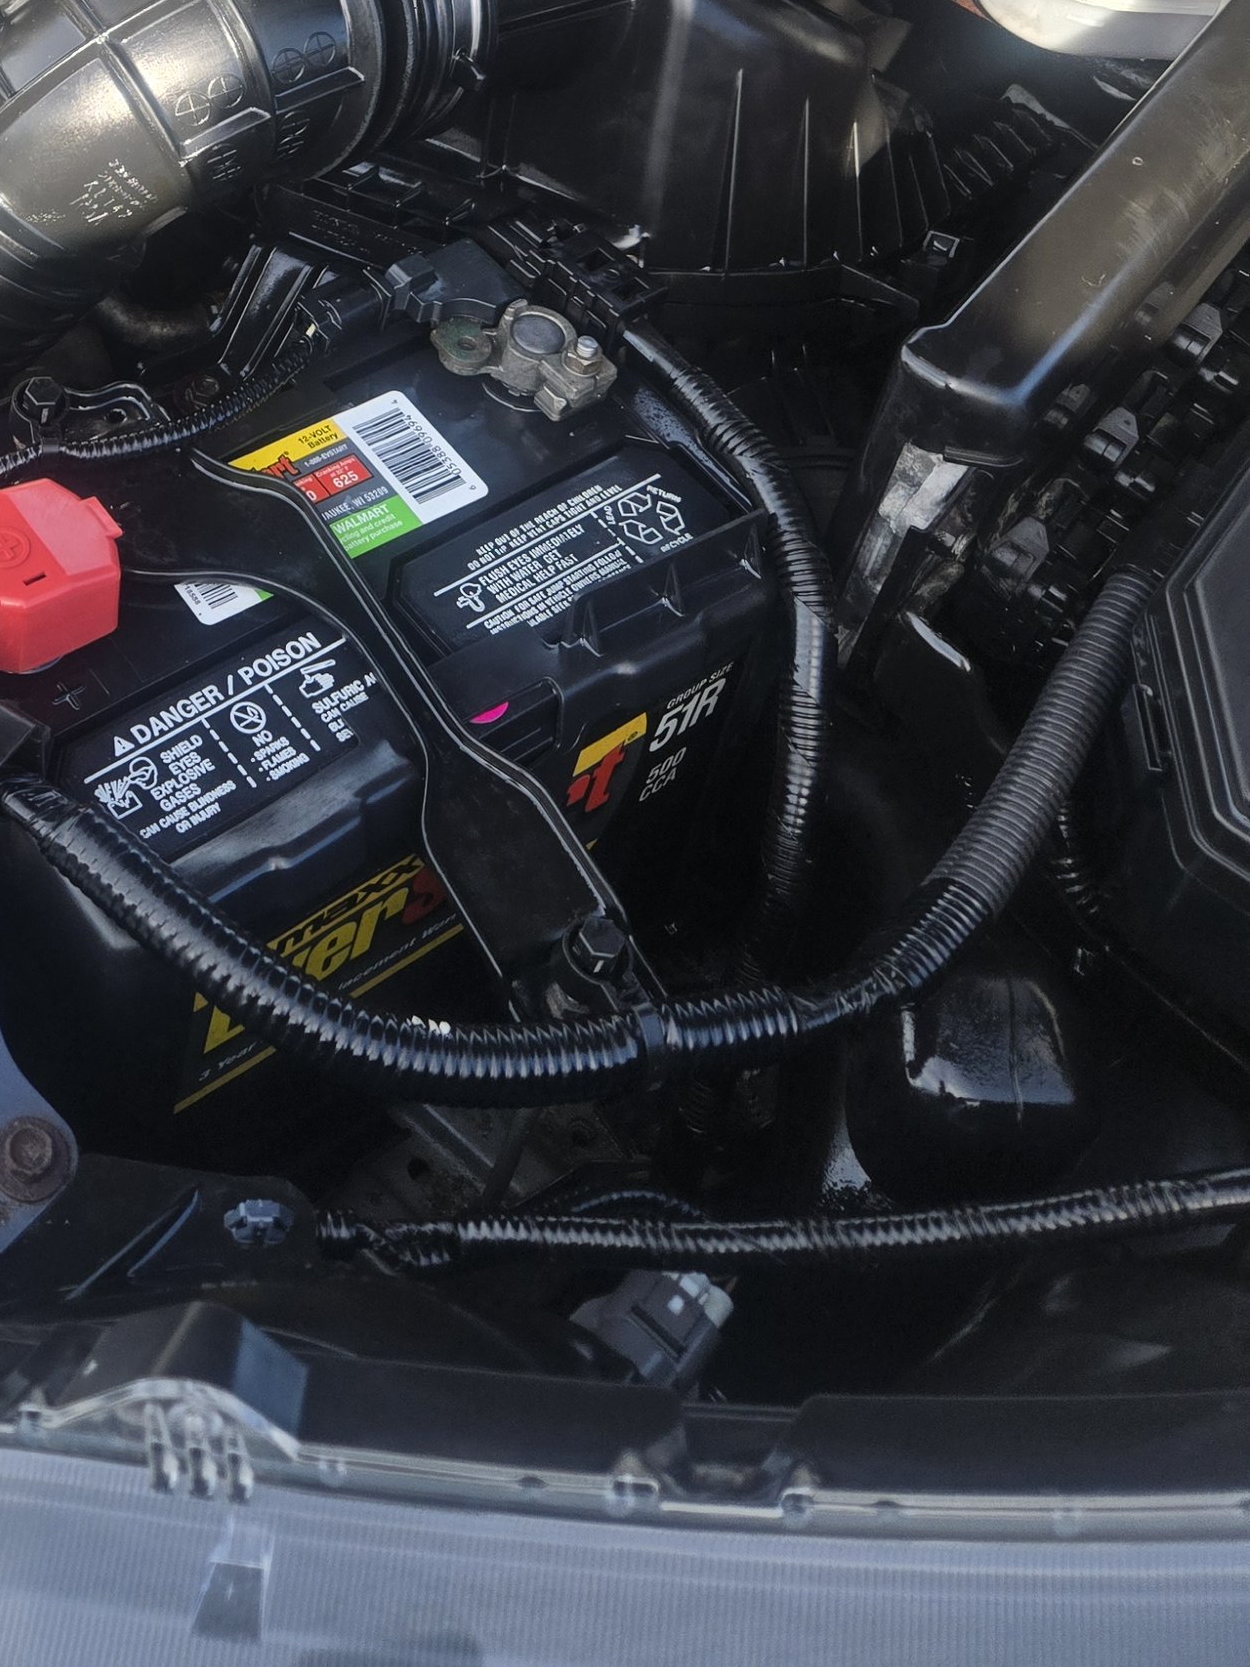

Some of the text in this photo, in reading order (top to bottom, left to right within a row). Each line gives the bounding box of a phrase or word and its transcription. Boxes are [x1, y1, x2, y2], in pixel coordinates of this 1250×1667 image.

[298, 425, 331, 444] 12-VOLT
[307, 433, 338, 449] Battery
[332, 471, 358, 488] 625
[351, 496, 366, 507] WI
[363, 486, 388, 502] 53209
[333, 504, 389, 534] WALMART
[360, 522, 374, 533] and
[374, 514, 396, 527] credit
[369, 520, 403, 540] purchase
[467, 560, 480, 571] DO
[479, 552, 495, 564] NOT
[509, 534, 527, 548] KEEP
[545, 514, 566, 528] CAPS
[564, 503, 586, 518] TIGHT
[585, 495, 600, 507] AND
[599, 485, 622, 501] LEVEL
[475, 485, 603, 556] KEEP OUT OF THE REACH OF CHILDREN
[604, 505, 616, 525] LEAD
[478, 524, 585, 586] FLUSH EYES IMMEDIATELY
[486, 549, 563, 594] WITH WATER GET
[495, 553, 579, 604] MEDICAL HELP FAST
[514, 600, 531, 613] FOR
[528, 591, 547, 605] SAFE
[546, 581, 565, 595] JUMP
[563, 563, 596, 583] STARTING
[544, 587, 573, 606] VEHICLE
[130, 684, 225, 744] DANGER
[237, 632, 322, 685] POISON
[311, 679, 365, 714] SULFURIC
[667, 661, 734, 709] GROUP SIZE
[320, 691, 369, 723] CAN CAUSE
[649, 678, 726, 752] 51R
[159, 734, 203, 764] SHIELD
[251, 730, 273, 747] NO
[253, 736, 290, 761] SPARKS
[168, 751, 202, 776] EYES
[261, 746, 297, 771] FLAMES
[269, 752, 310, 781] SMOKING
[646, 746, 687, 784] 500
[150, 758, 216, 801] EXPLOSIVE
[639, 767, 676, 801] CCA
[139, 780, 237, 839] CAN CAUSE BLINDNESS
[159, 783, 202, 812] GASES
[175, 802, 221, 833] OR INJURY
